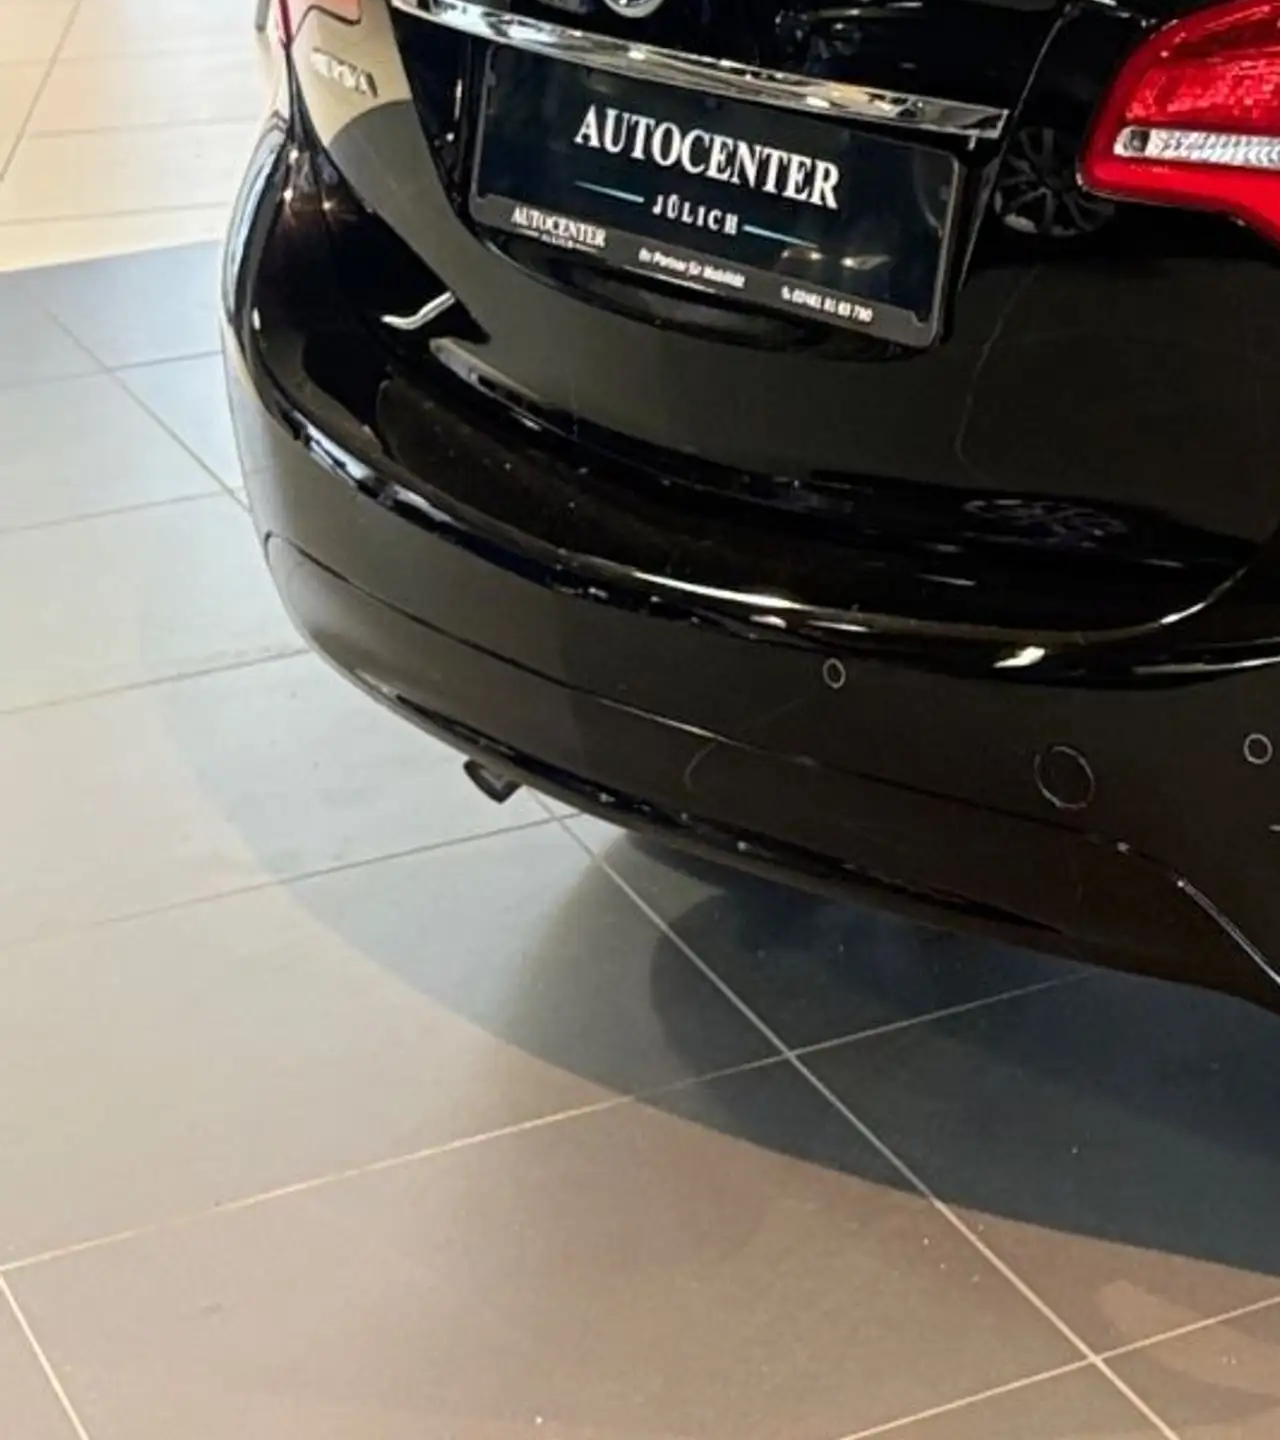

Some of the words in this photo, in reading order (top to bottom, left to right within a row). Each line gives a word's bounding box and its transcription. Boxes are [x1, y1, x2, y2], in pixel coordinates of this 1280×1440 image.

[573, 103, 841, 211] AUTOCENTER
[510, 204, 607, 249] AUTOCENTER
[651, 193, 740, 237] JÜLICH
